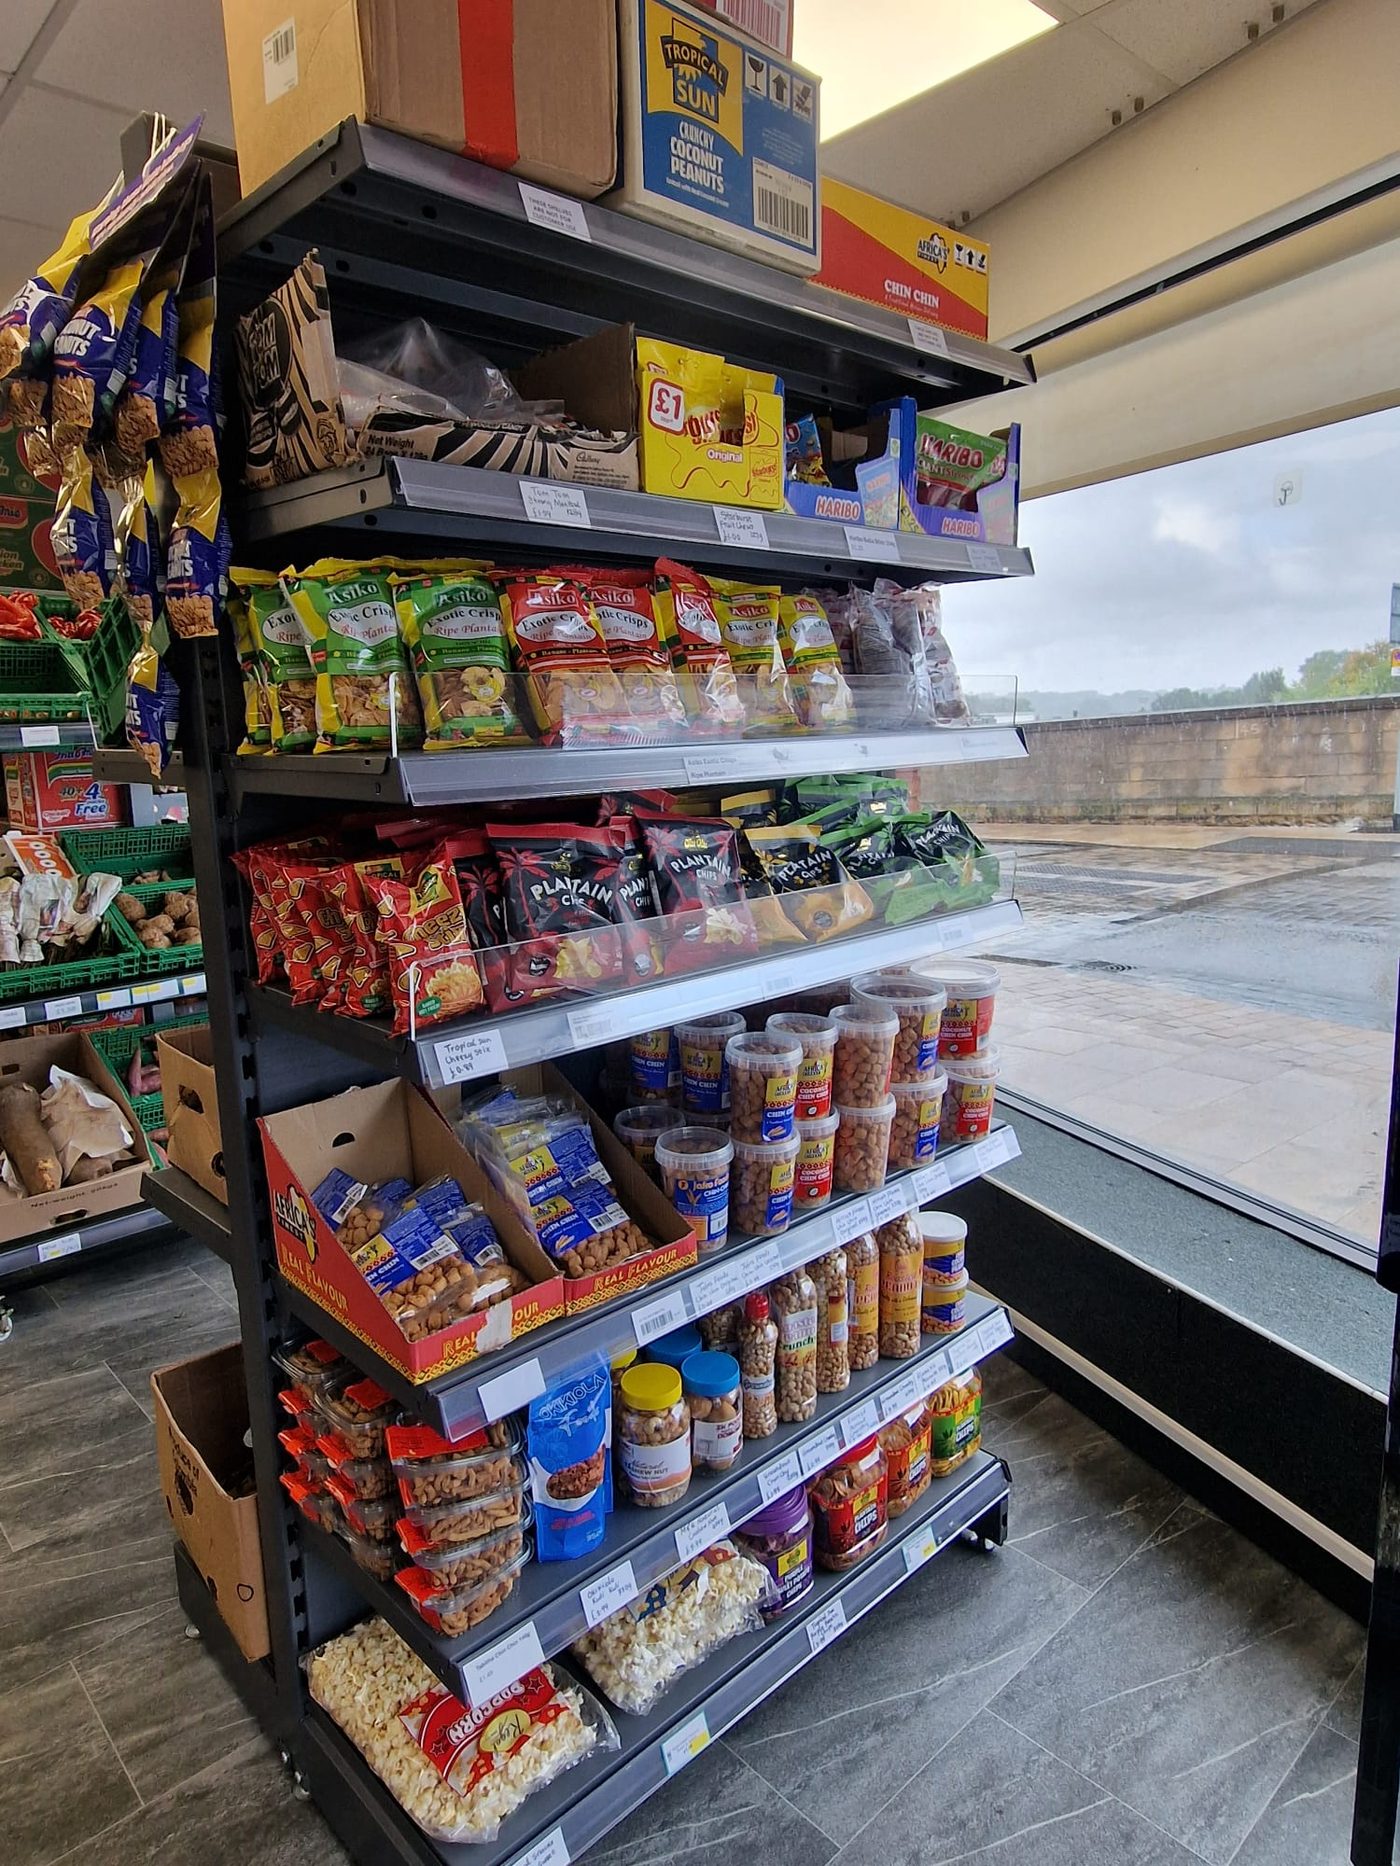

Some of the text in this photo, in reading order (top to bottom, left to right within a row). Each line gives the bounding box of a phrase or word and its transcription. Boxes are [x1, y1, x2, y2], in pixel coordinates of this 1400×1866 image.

[664, 43, 724, 87] TROPICAL
[676, 80, 715, 117] SUN
[680, 121, 714, 151] CRUNCHY
[671, 137, 723, 174] COCONUT
[671, 156, 724, 194] PEANUTS
[917, 240, 949, 260] AFRICA'S
[884, 279, 912, 299] CHIN
[913, 290, 940, 309] CHIN
[655, 387, 682, 420] £1
[368, 434, 415, 449] Net Weight
[920, 432, 984, 469] HARIBO
[707, 448, 743, 463] Original
[815, 496, 861, 521] HARIBO
[942, 517, 979, 537] HARIBO
[327, 584, 378, 604] Asiko
[437, 591, 488, 605] Asiko
[534, 591, 576, 606] Asiko
[590, 588, 632, 604] Asiko
[361, 605, 396, 621] Crisp
[427, 608, 502, 628] Exotic Crisp
[616, 612, 649, 629] Crisps
[731, 605, 769, 617] Asiko
[433, 624, 497, 636] Ripe Planta
[522, 613, 560, 632] Exotic
[84, 782, 100, 800] 4
[75, 803, 107, 816] Free
[670, 853, 732, 878] PLANTAIN
[696, 868, 718, 882] CHIPS
[619, 878, 650, 901] PLAN
[444, 1038, 477, 1054] Tropical
[646, 1060, 666, 1068] CHIN
[698, 1080, 719, 1089] CHIN
[798, 1092, 816, 1101] CHIN
[767, 1110, 785, 1118] CHIN
[800, 1173, 817, 1182] CHIN
[274, 1190, 316, 1242] AFRICA'S
[541, 1213, 579, 1238] CHIN CHIN
[378, 1256, 400, 1274] CHIN
[593, 1248, 678, 1291] REAL FLAVOUR
[280, 1241, 349, 1312] REAL FLAVOUR
[440, 1331, 476, 1357] REAL
[539, 1372, 605, 1420] OKIKIOLA
[653, 1467, 669, 1475] NUT
[854, 1509, 878, 1536] CHIPS
[446, 1681, 526, 1745] POPCORN
[490, 1712, 524, 1754] Regal
